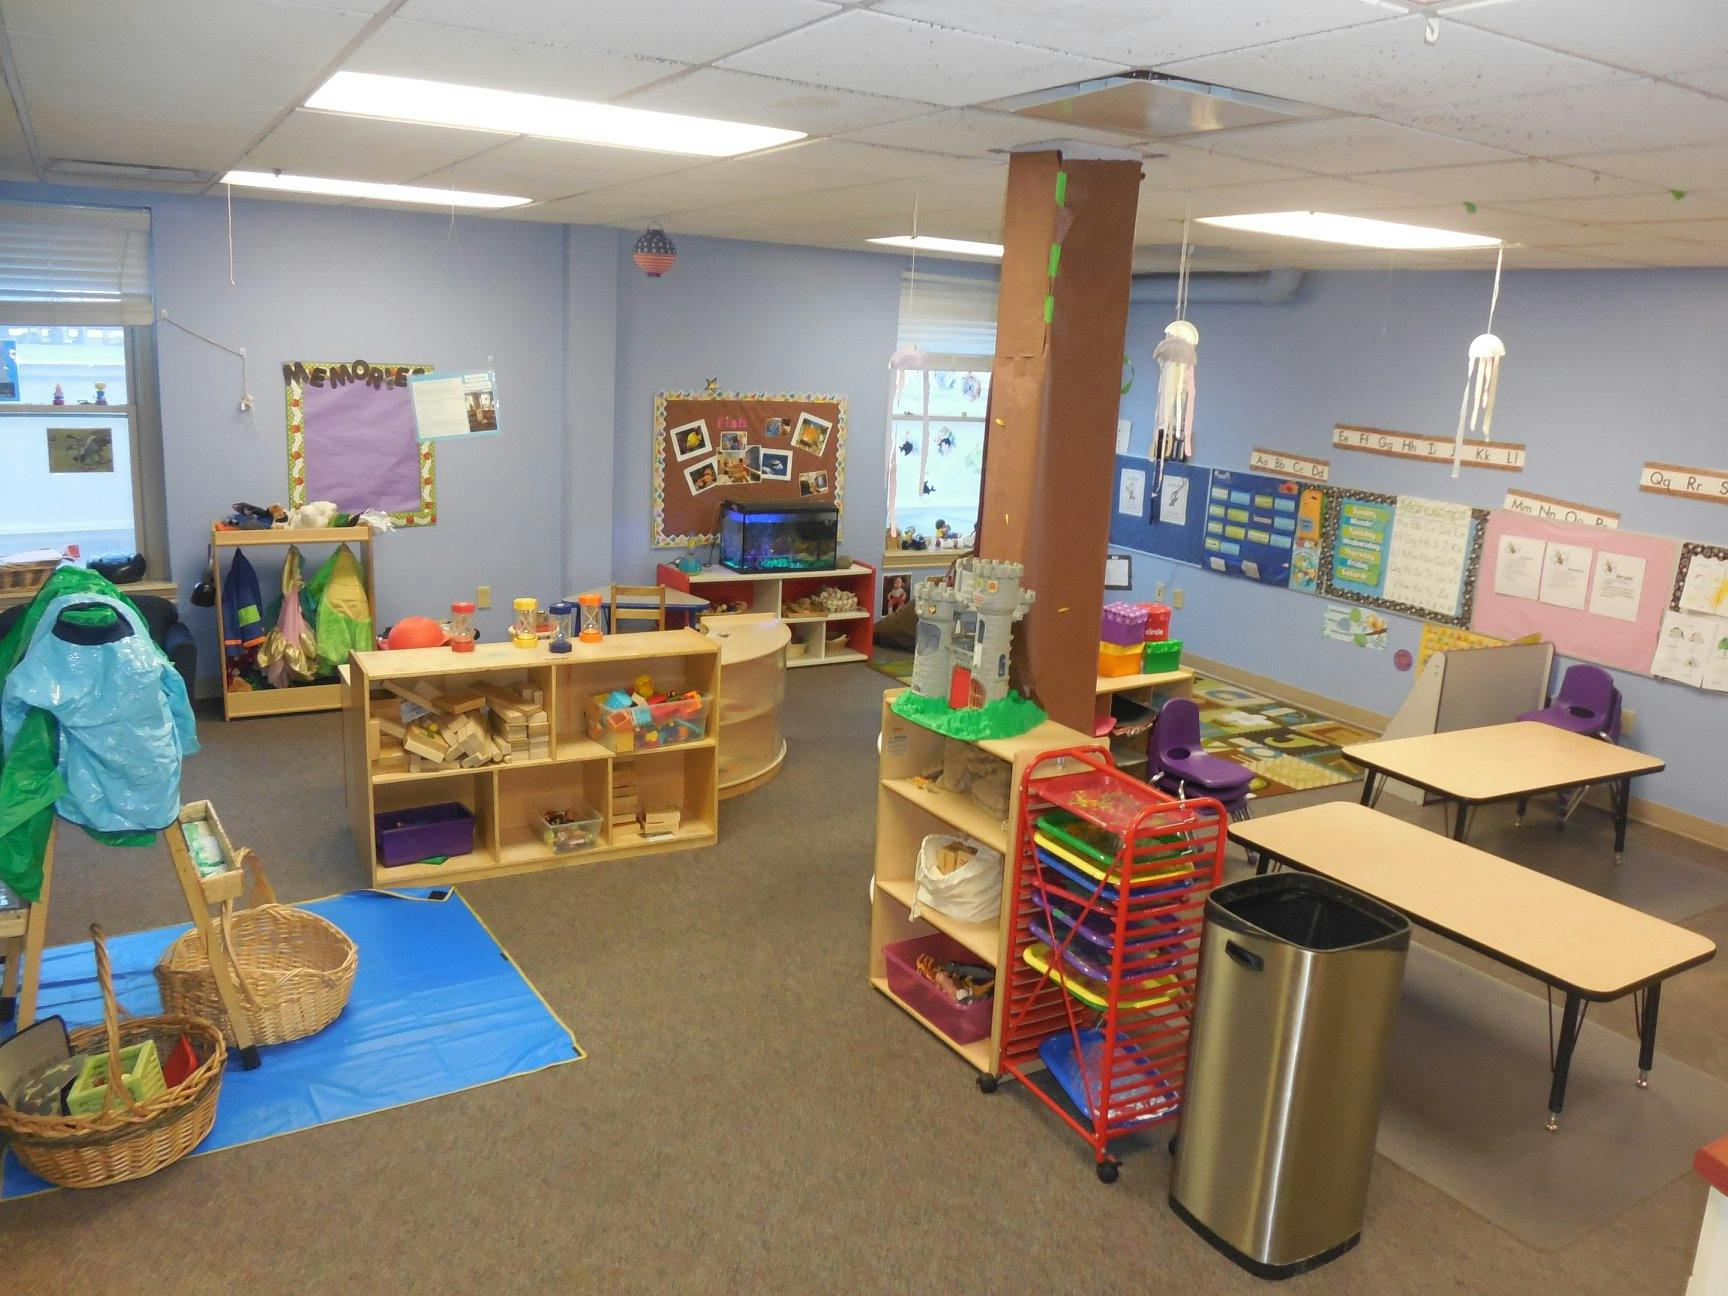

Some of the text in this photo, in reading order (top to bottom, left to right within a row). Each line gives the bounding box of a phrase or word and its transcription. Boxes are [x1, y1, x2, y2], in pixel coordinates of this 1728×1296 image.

[1359, 433, 1369, 445] Ff
[1378, 436, 1393, 451] Gg
[1402, 440, 1416, 452] Hh
[1476, 448, 1490, 461] Kk
[1507, 451, 1518, 464] Ll
[1256, 455, 1325, 478] Aa Bb Cc Dd
[1650, 471, 1671, 493] Qq
[1686, 476, 1703, 492] Rr
[1511, 499, 1532, 513] Mm
[1538, 505, 1556, 519] Nn
